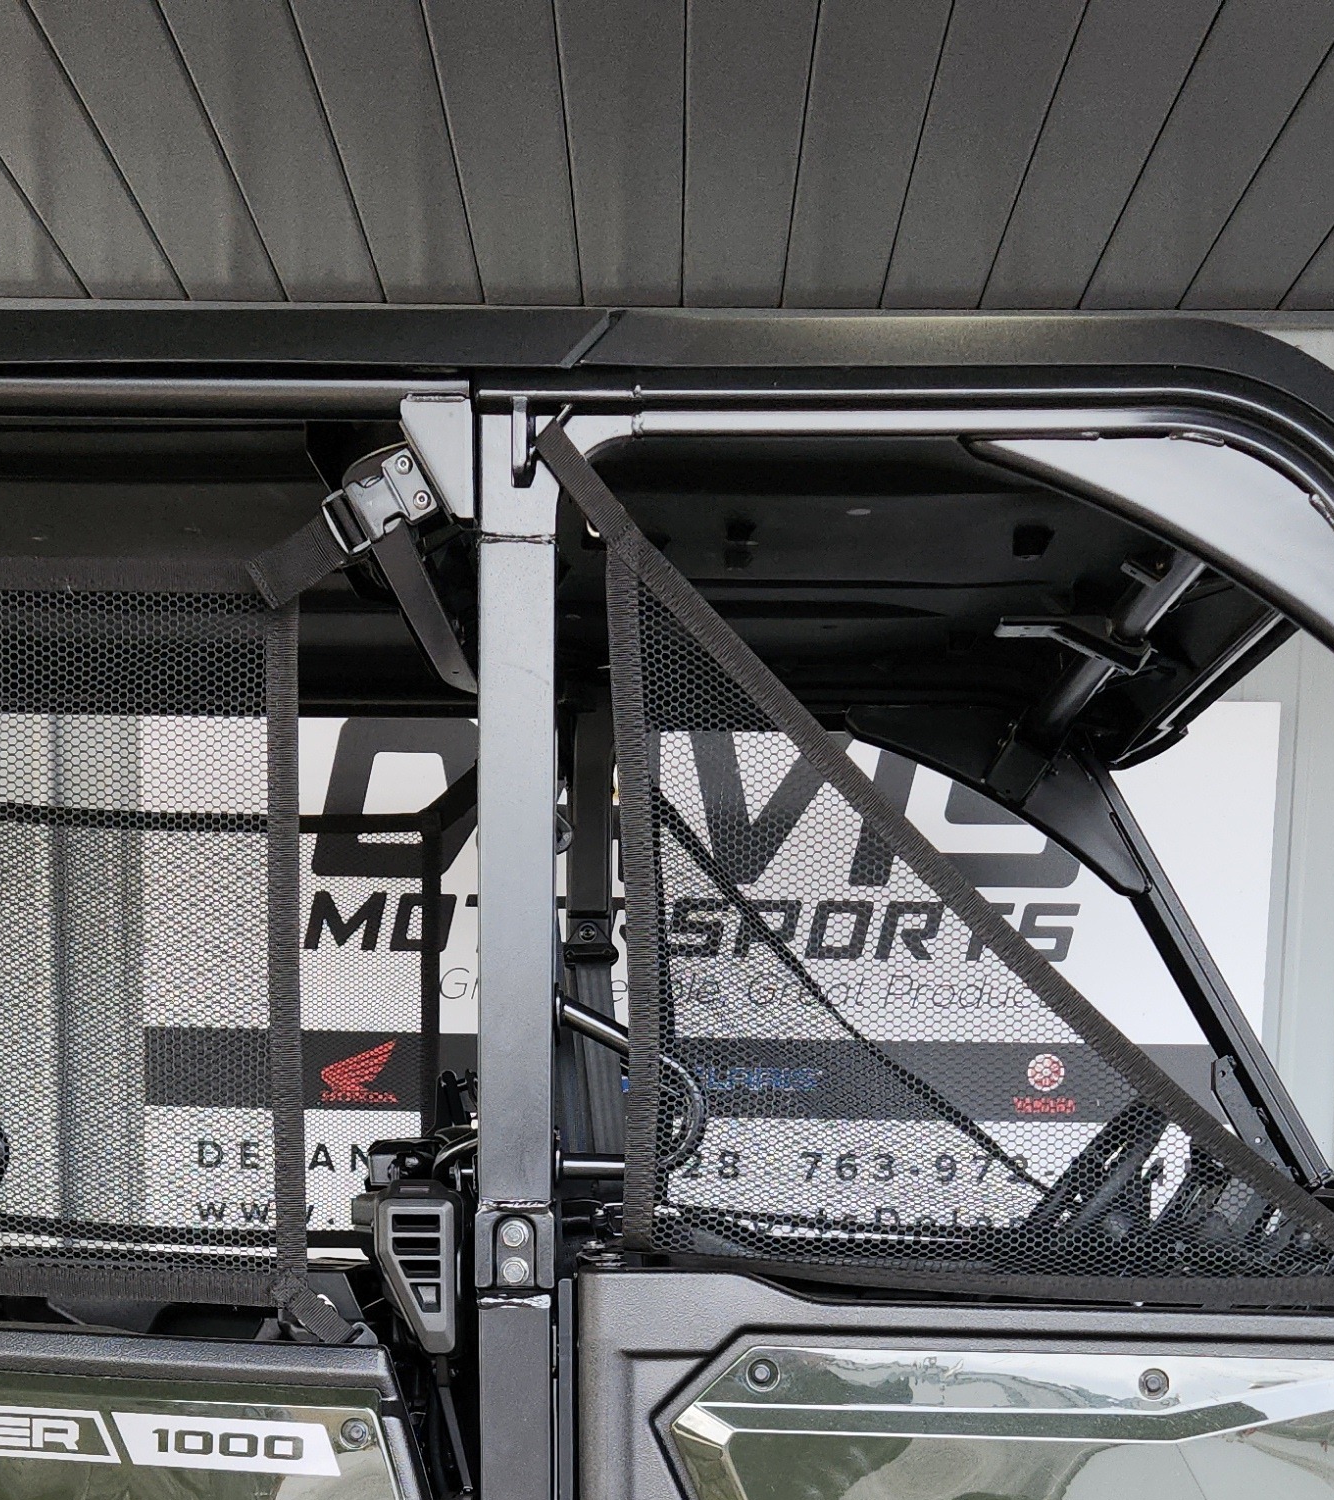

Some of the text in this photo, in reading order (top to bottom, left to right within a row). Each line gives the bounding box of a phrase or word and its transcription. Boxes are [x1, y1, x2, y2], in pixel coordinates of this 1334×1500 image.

[312, 718, 1081, 888] DVIS
[304, 890, 1081, 962] MOSPORTS
[883, 974, 1043, 1009] Produc
[151, 1428, 305, 1460] 1000
